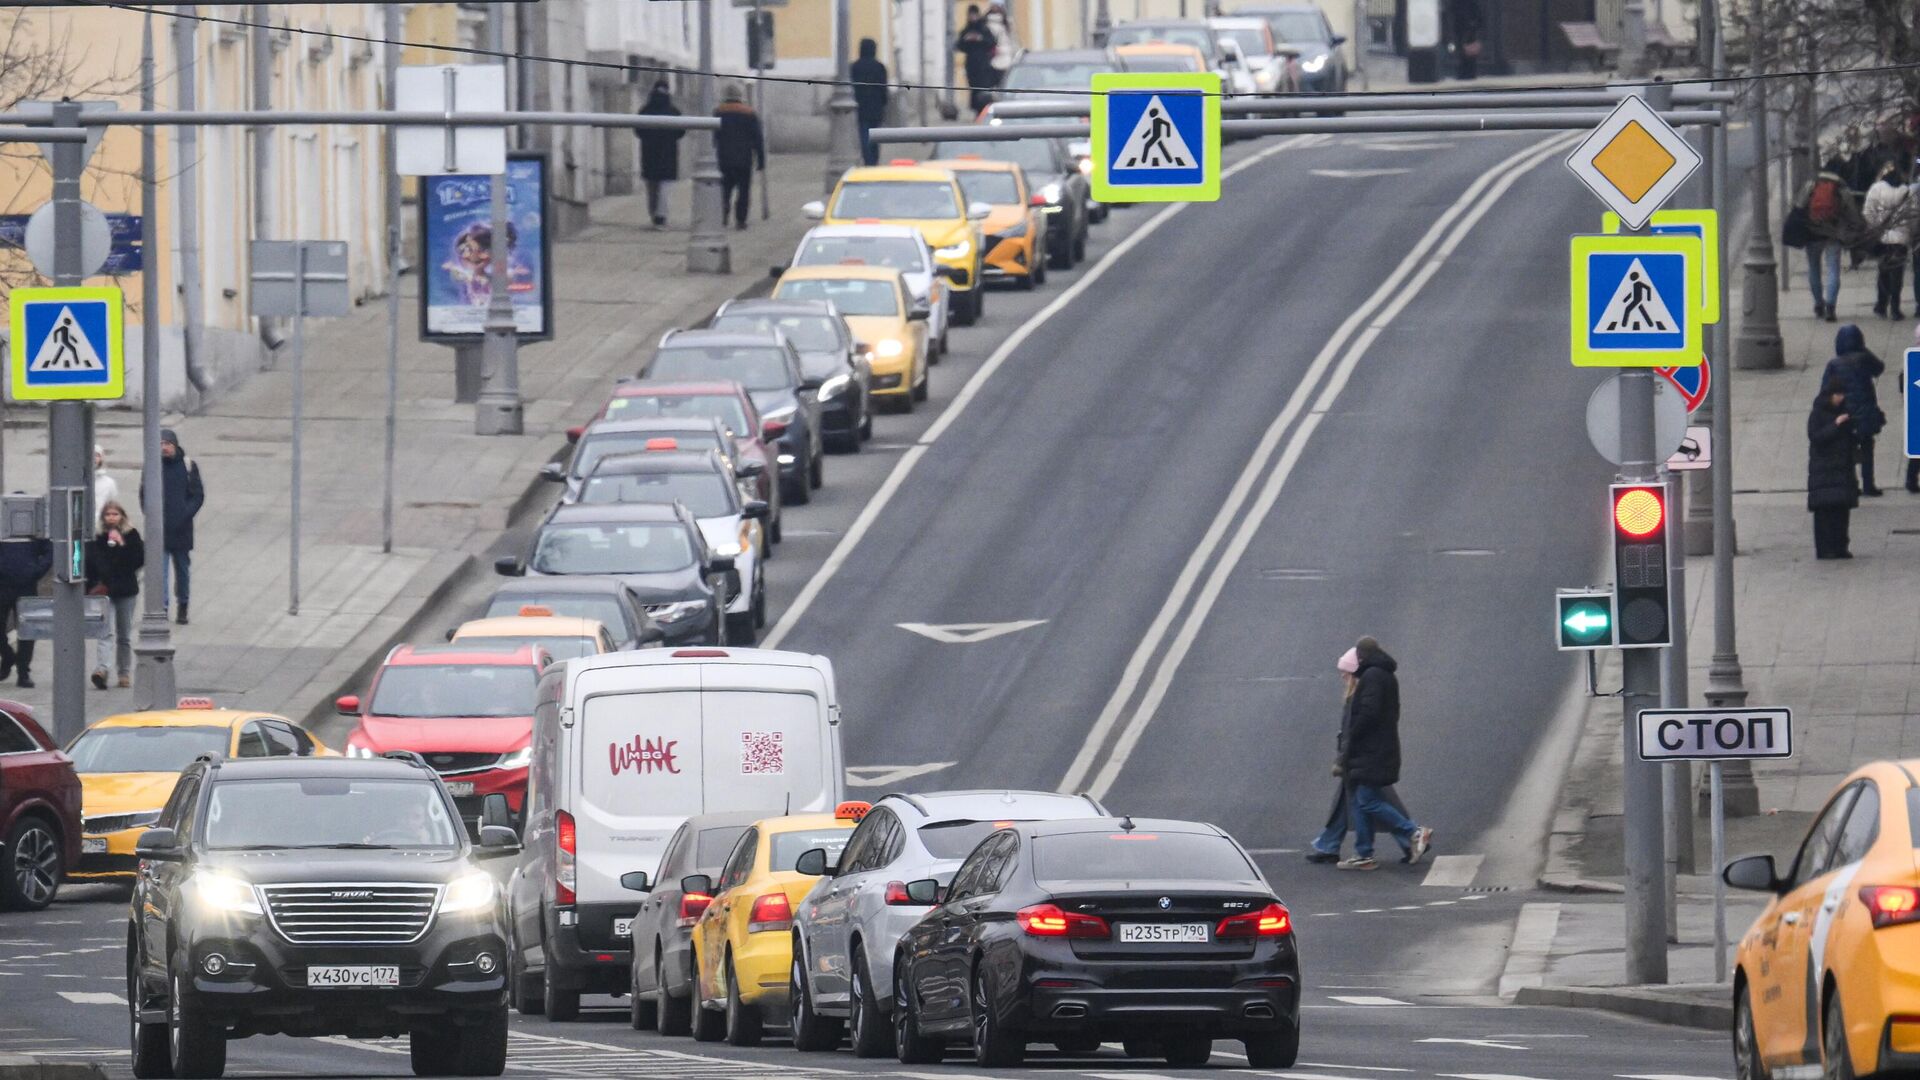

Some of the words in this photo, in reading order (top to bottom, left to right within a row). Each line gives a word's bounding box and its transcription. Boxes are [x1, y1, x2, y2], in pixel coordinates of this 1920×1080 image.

[1658, 718, 1774, 751] СТОП
[609, 734, 681, 776] WINE
[629, 751, 662, 760] MBG
